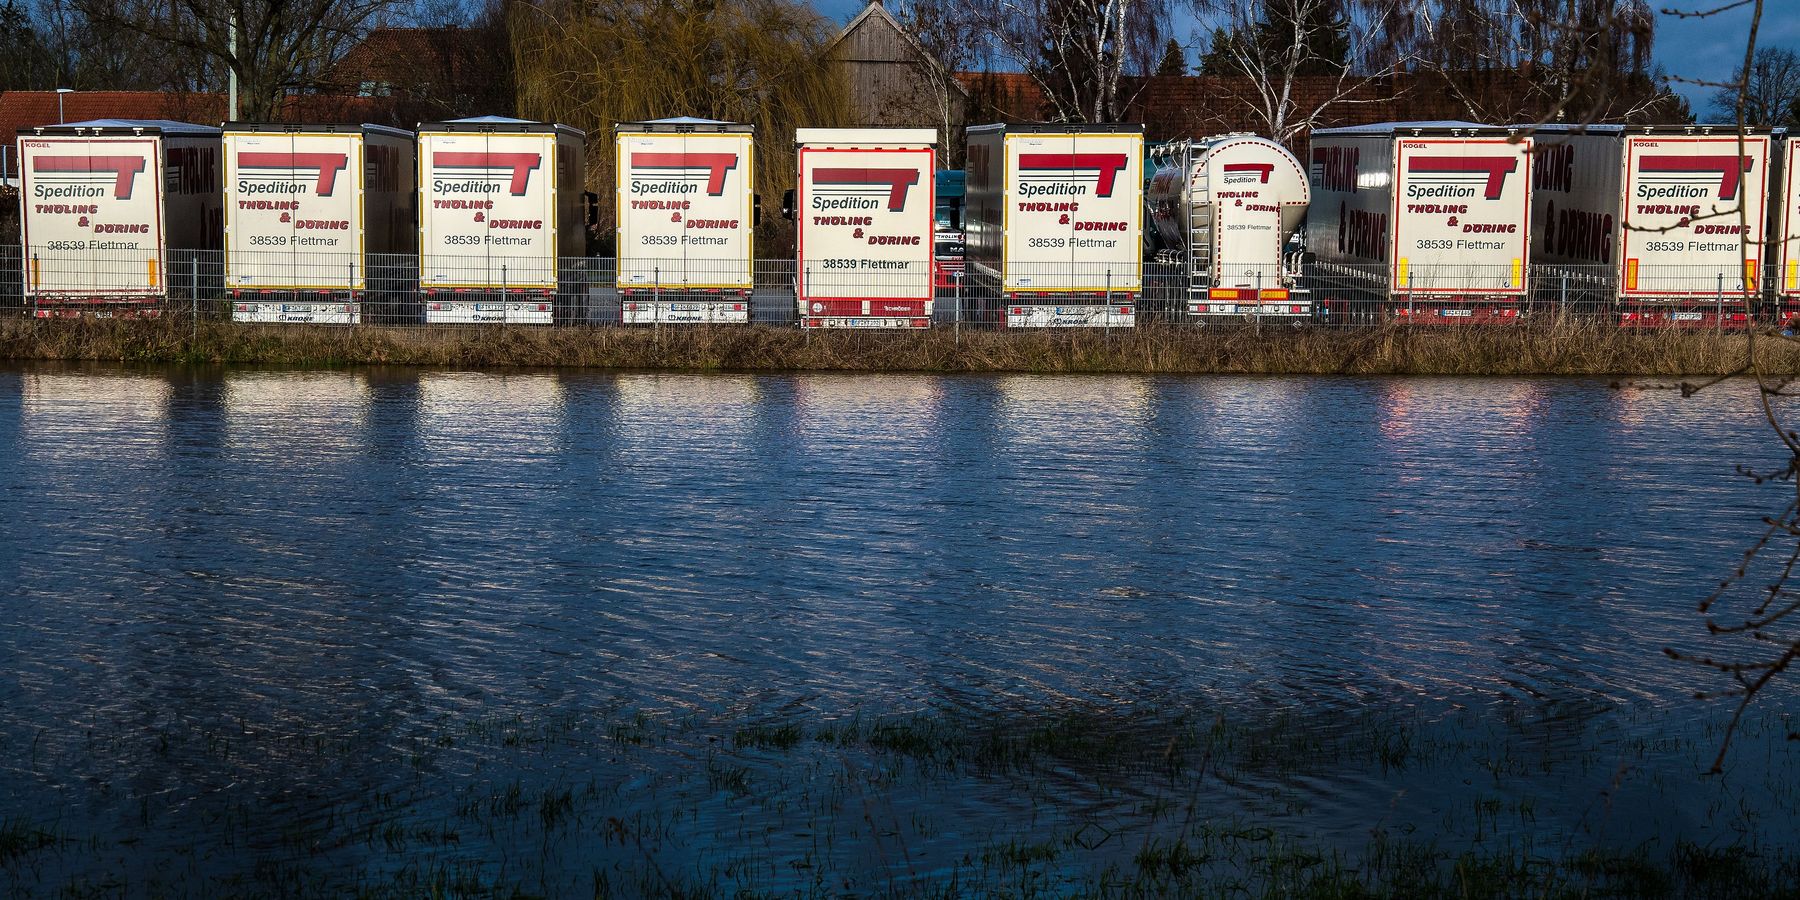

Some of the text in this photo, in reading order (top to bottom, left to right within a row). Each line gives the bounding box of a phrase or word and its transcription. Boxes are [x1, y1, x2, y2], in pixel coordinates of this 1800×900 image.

[34, 184, 104, 200] Spedition
[238, 180, 306, 196] Spedition
[433, 180, 500, 195] Spedition
[631, 181, 697, 196] Spedition
[1018, 183, 1086, 198] Spedition
[1407, 185, 1475, 200] Spedition
[1637, 185, 1708, 200] Spedition
[812, 196, 878, 212] Spedition
[1235, 198, 1243, 206] &
[78, 216, 89, 227] &
[279, 212, 291, 223] &
[473, 212, 485, 222] &
[671, 212, 681, 222] &
[1059, 214, 1070, 224] &
[1447, 216, 1458, 226] &
[853, 228, 864, 239] &
[47, 240, 139, 250] 38539 Flettmar
[249, 236, 338, 246] 38539 Flettmar
[444, 235, 531, 246] 38539 Flettmar
[641, 235, 728, 245] 38539 Flettmar
[1028, 238, 1117, 248] 38539 Flettmar
[1416, 240, 1505, 250] 38539 Flettmar
[1646, 242, 1739, 252] 38539 Flettmar
[823, 259, 909, 269] 38539 Flettmar
